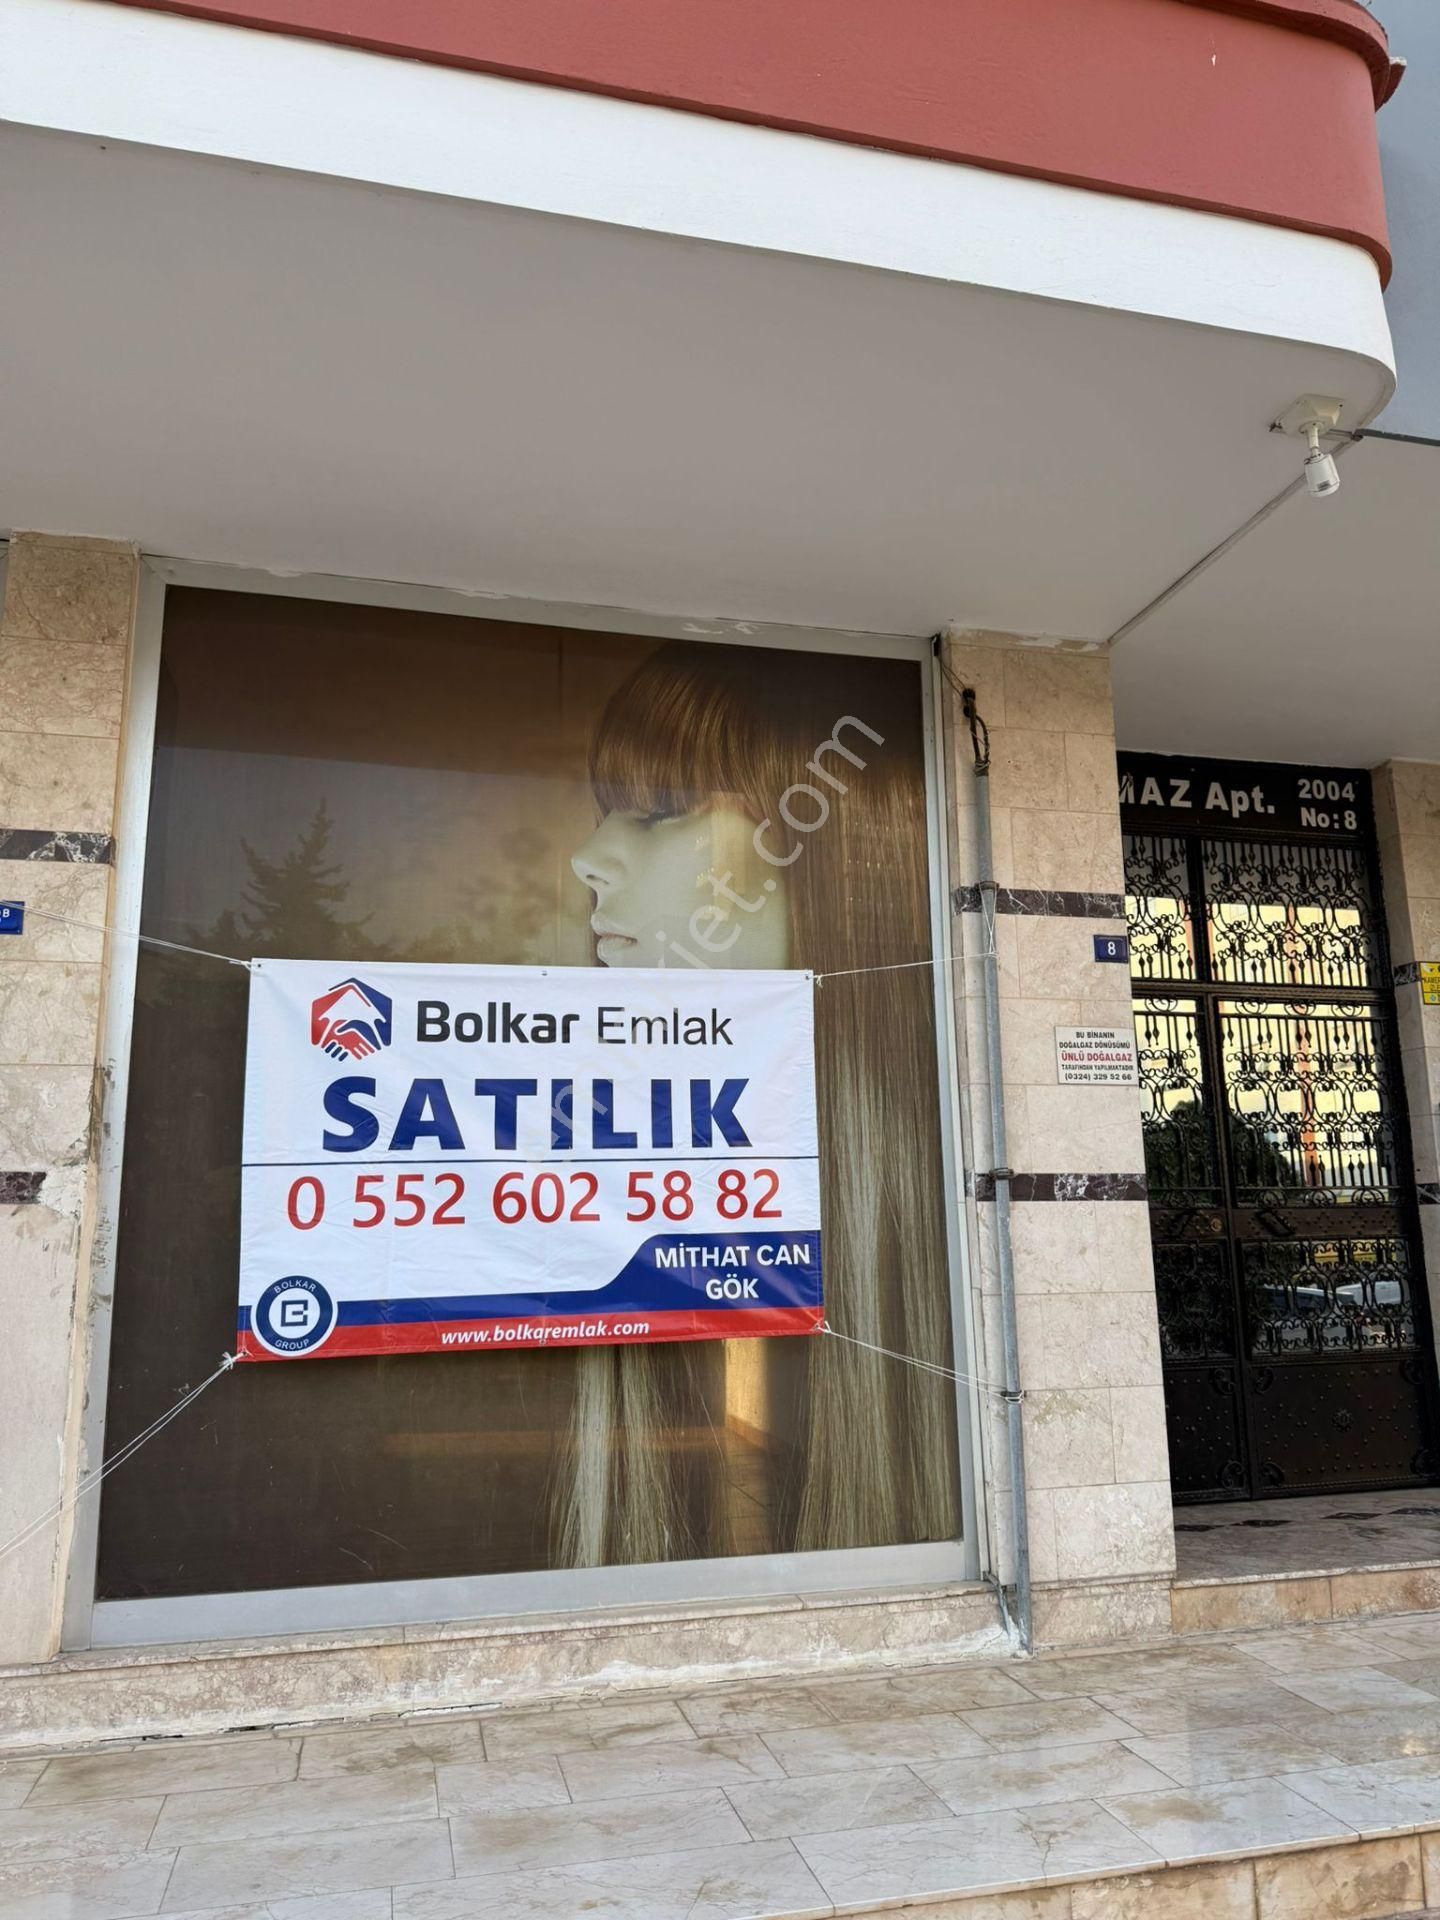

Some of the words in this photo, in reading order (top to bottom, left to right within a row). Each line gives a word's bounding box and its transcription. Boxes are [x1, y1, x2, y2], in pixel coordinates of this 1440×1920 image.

[1205, 782, 1275, 818] Apt.
[1298, 779, 1356, 802] 2004
[1107, 941, 1116, 956] 8
[416, 1000, 580, 1044] Bolkar
[598, 1006, 733, 1046] Emlak
[1076, 1031, 1085, 1039] BU
[1087, 1030, 1115, 1039] BİNANIN
[1059, 1041, 1093, 1049] DOĞALGAZ
[1061, 1050, 1084, 1061] ÜNLÜ
[1087, 1051, 1133, 1061] DOĞALGAZ
[1065, 1072, 1091, 1081] (0324)
[322, 1076, 753, 1153] SATILIK
[287, 1176, 325, 1230] 0
[353, 1172, 466, 1229] 552
[492, 1171, 600, 1225] 602
[627, 1169, 694, 1223] 58
[716, 1168, 783, 1220] 82
[655, 1242, 750, 1268] MİTHAT
[756, 1244, 811, 1266] CAN
[273, 1280, 317, 1294] BOLKAR
[705, 1273, 759, 1300] GÖK
[441, 1320, 650, 1345] www.bolkaremlak.com
[275, 1339, 310, 1350] GROUP
